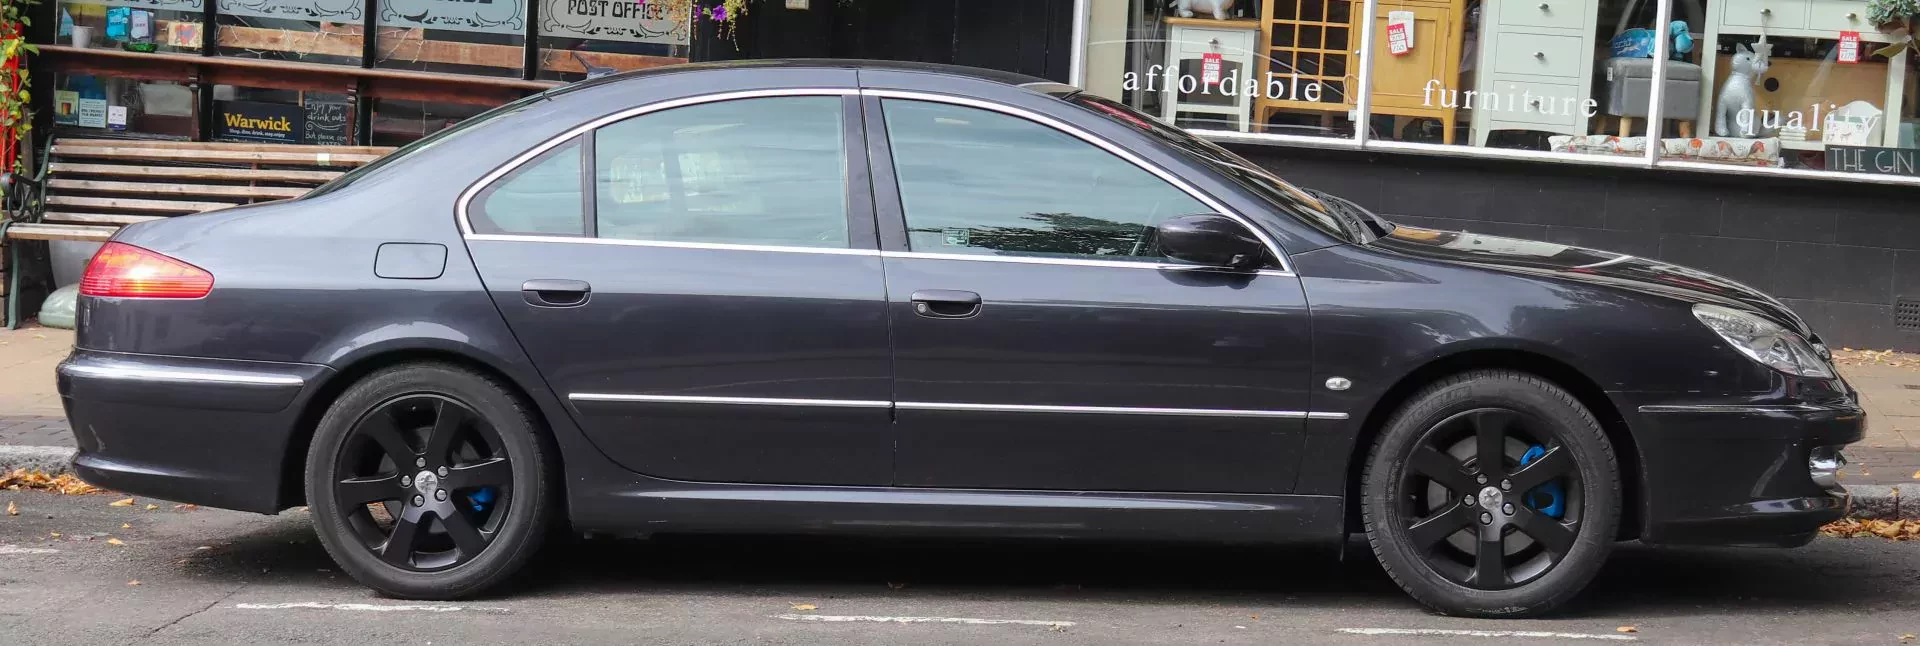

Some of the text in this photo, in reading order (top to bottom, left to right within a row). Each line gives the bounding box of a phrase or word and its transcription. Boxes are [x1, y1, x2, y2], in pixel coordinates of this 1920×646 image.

[567, 0, 609, 17] POST
[1122, 64, 1881, 143] affordable furniture quality
[224, 112, 291, 132] Warwick
[307, 112, 331, 122] drink
[1830, 147, 1914, 174] THE GIN
